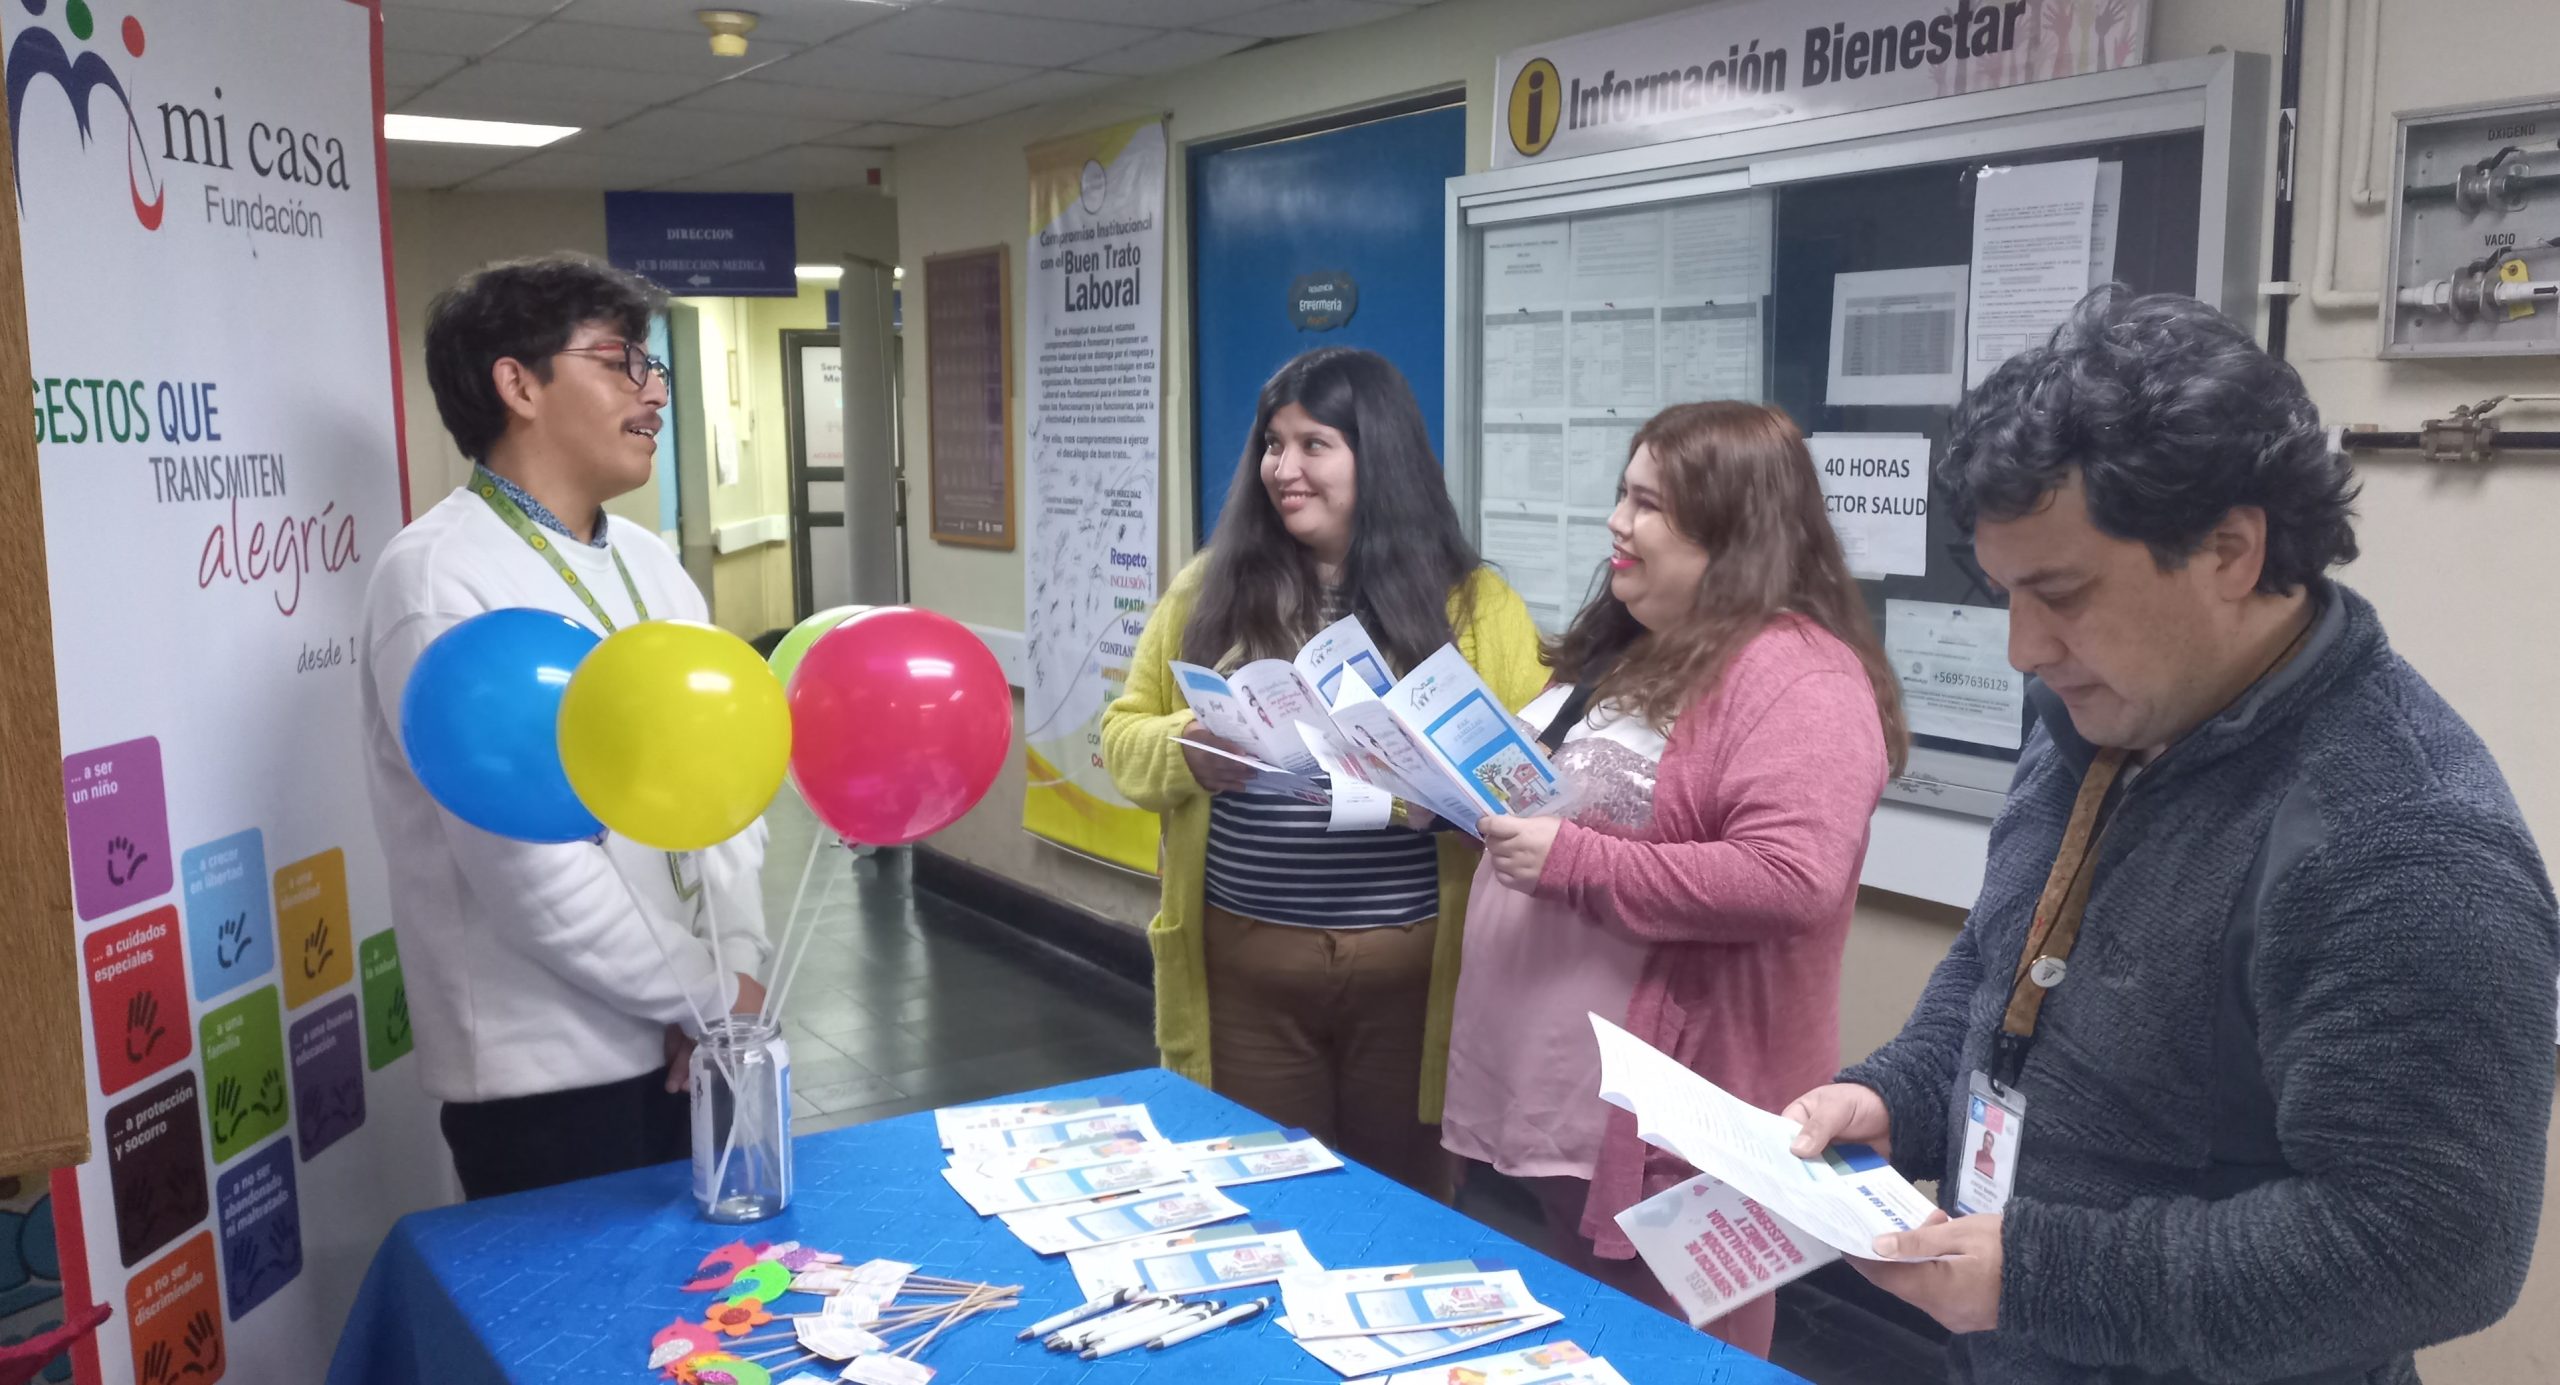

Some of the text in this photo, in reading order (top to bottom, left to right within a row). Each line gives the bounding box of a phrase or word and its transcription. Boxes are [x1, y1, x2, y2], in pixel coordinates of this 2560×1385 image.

[1569, 37, 1787, 131] Información
[1801, 1, 2028, 89] Bienestar
[157, 86, 350, 191] mi casa
[2488, 123, 2536, 141] OXIGENO
[204, 184, 324, 239] Fundación
[666, 228, 734, 241] DIRECCION
[1040, 212, 1153, 248] Compromiso Institucional
[2484, 233, 2516, 247] VACIO
[659, 259, 721, 272] DIRECCION
[722, 259, 766, 272] MEDICA
[1040, 242, 1141, 275] con el Buen Trato
[1064, 268, 1140, 313] Laboral
[156, 380, 222, 445] QUE
[149, 453, 287, 503] TRANSMITEN
[1824, 458, 1911, 479] 40 HORAS
[1826, 493, 1928, 517] CTOR SALUD
[199, 496, 361, 616] alegría
[1110, 547, 1147, 571] Respeto
[1110, 574, 1146, 590] INCLUSIÓN
[1113, 596, 1145, 612] EMPATÍA
[297, 638, 342, 674] desde
[1933, 671, 2010, 692] +56957636129
[84, 759, 113, 780] a ser
[72, 779, 119, 805] un niño
[208, 848, 238, 868] crecer
[190, 865, 244, 895] en libertad
[105, 922, 167, 958] a cuidados
[94, 949, 155, 983] especiales
[126, 1086, 194, 1132] a protección
[114, 1121, 168, 1161] y socorro
[232, 1162, 272, 1196] a no ser
[224, 1173, 283, 1222] abandonado
[226, 1189, 289, 1240] ni maltratado
[1733, 1216, 1747, 1226] Y
[1706, 1208, 1771, 1282] ESPECIALIZADA
[1741, 1225, 1770, 1253] NIÑEZ
[1684, 1239, 1736, 1299] SERVICIO DE
[1699, 1230, 1750, 1290] PROTECCIÓN
[1762, 1251, 1777, 1266] LA
[145, 1260, 189, 1298] a no ser
[134, 1270, 204, 1328] discriminado
